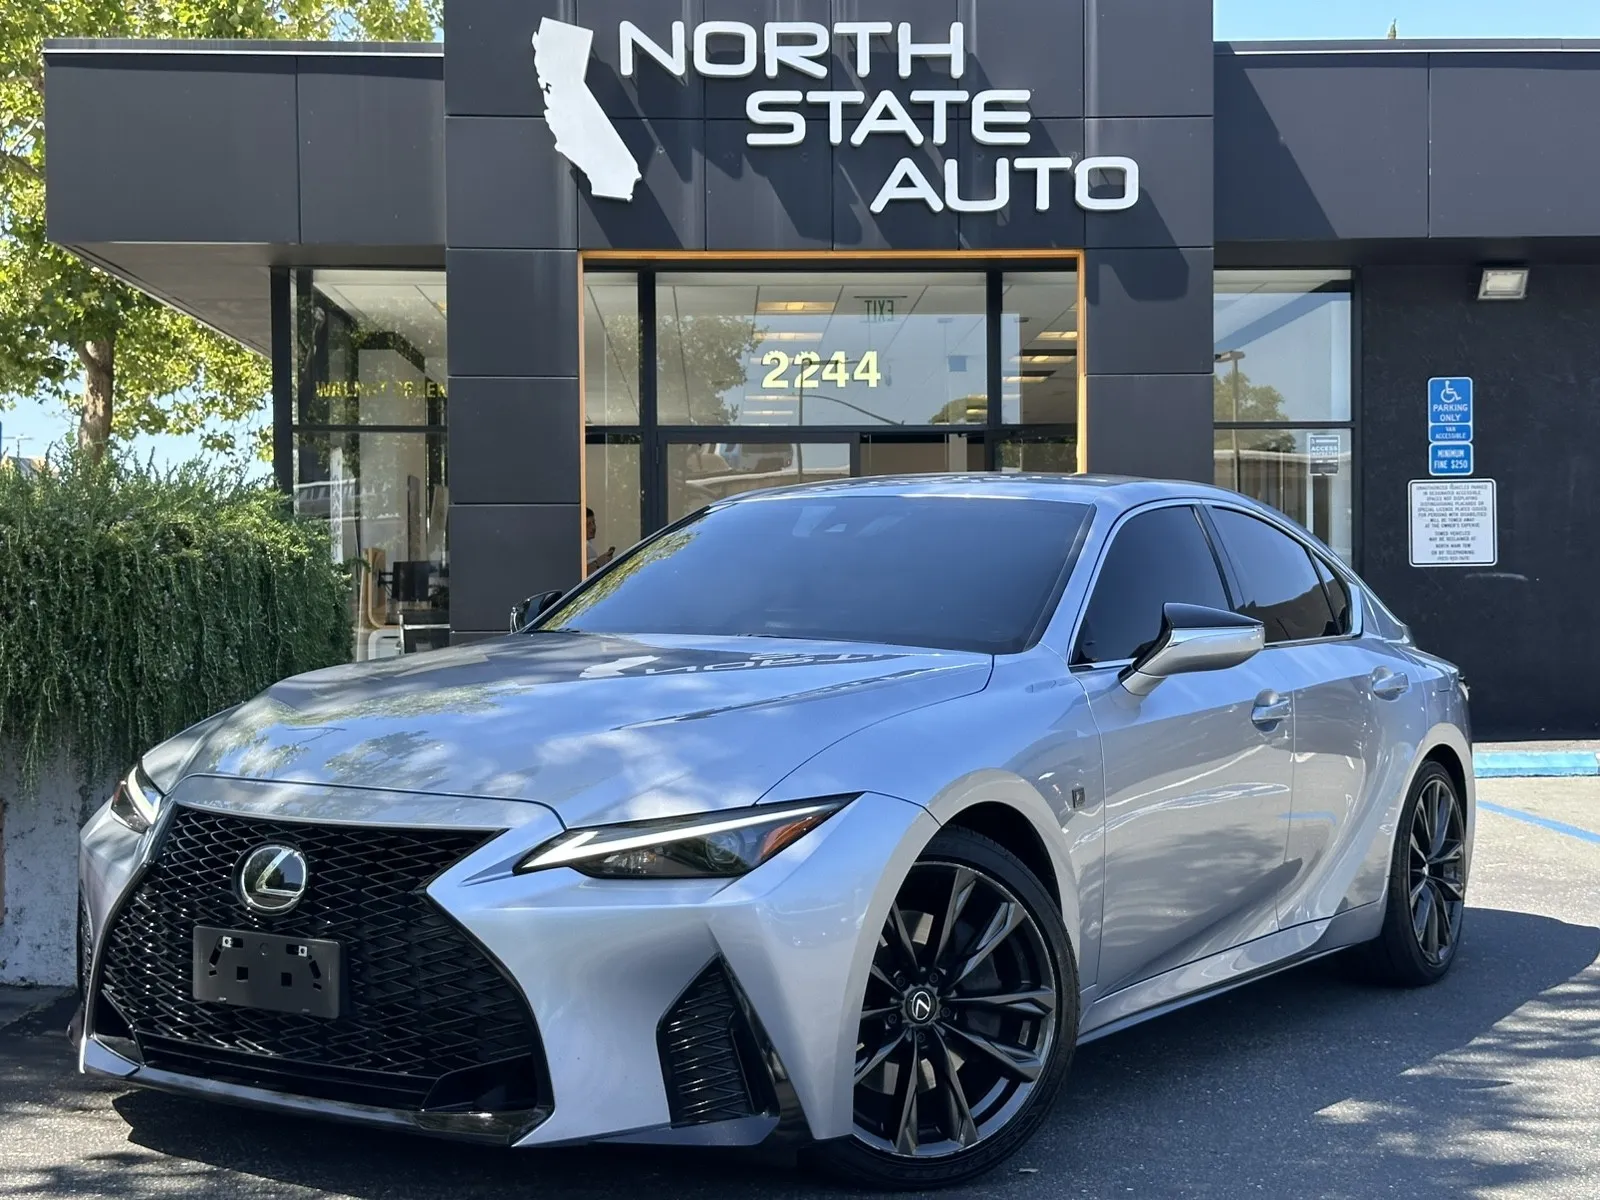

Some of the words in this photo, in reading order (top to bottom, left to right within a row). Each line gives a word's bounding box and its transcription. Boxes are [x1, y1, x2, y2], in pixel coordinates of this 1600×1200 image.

[618, 20, 965, 79] NORTH
[745, 89, 1032, 147] STATE
[869, 156, 1140, 214] AUTO
[761, 350, 882, 389] 2244
[1432, 403, 1468, 412] PARKING
[1439, 413, 1461, 422] ONLY
[1433, 460, 1448, 469] FINE
[1450, 460, 1468, 469] $250
[1437, 449, 1465, 458] MINIMUM
